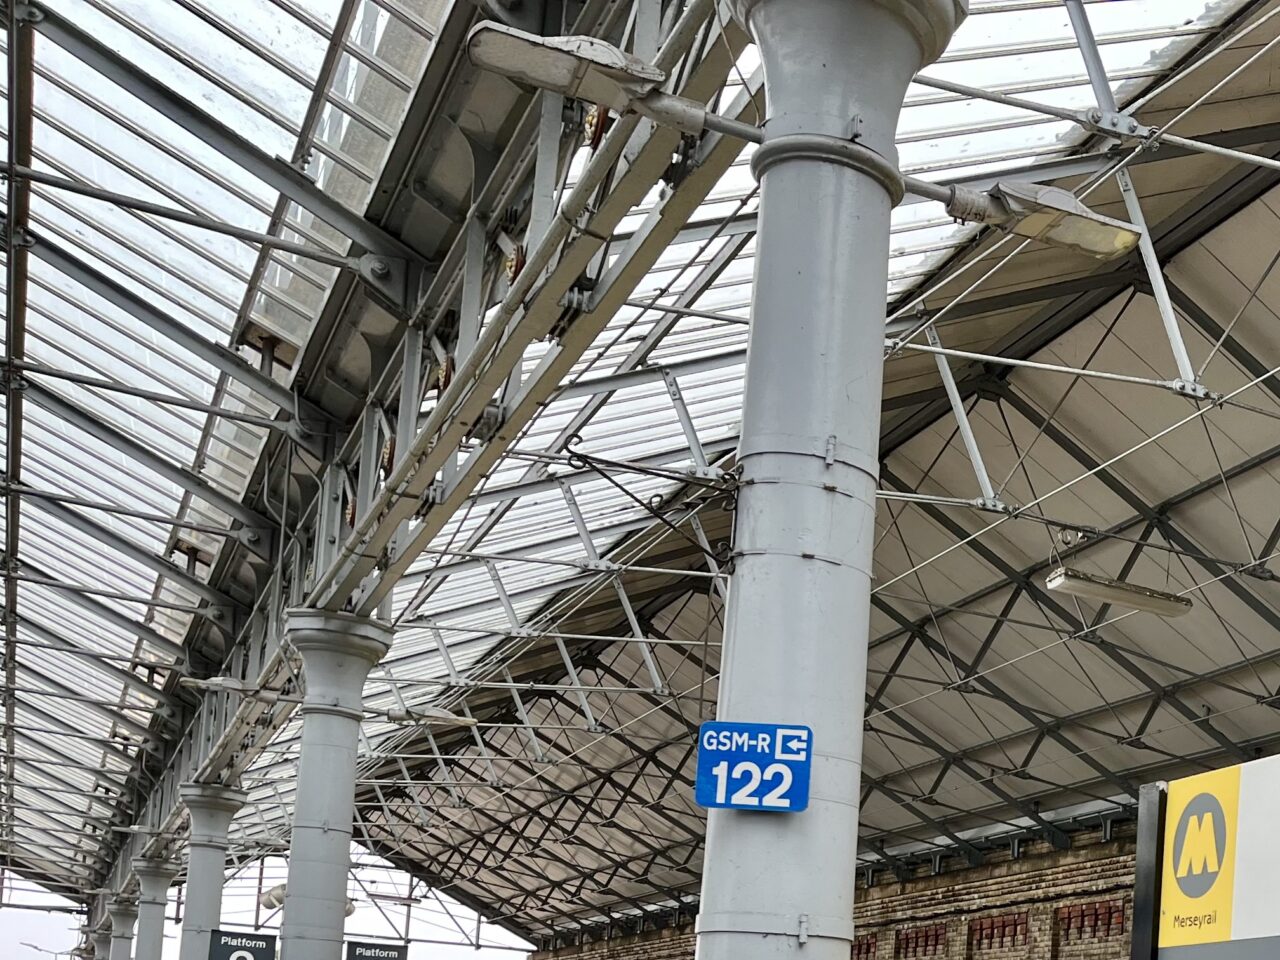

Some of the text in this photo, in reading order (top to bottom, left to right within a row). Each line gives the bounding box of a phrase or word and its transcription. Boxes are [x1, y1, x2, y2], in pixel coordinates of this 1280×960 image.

[703, 730, 771, 753] GSM-R
[711, 761, 793, 808] 122
[1173, 909, 1217, 930] Merseyrail
[220, 936, 267, 949] Platform
[355, 947, 398, 958] Platform
